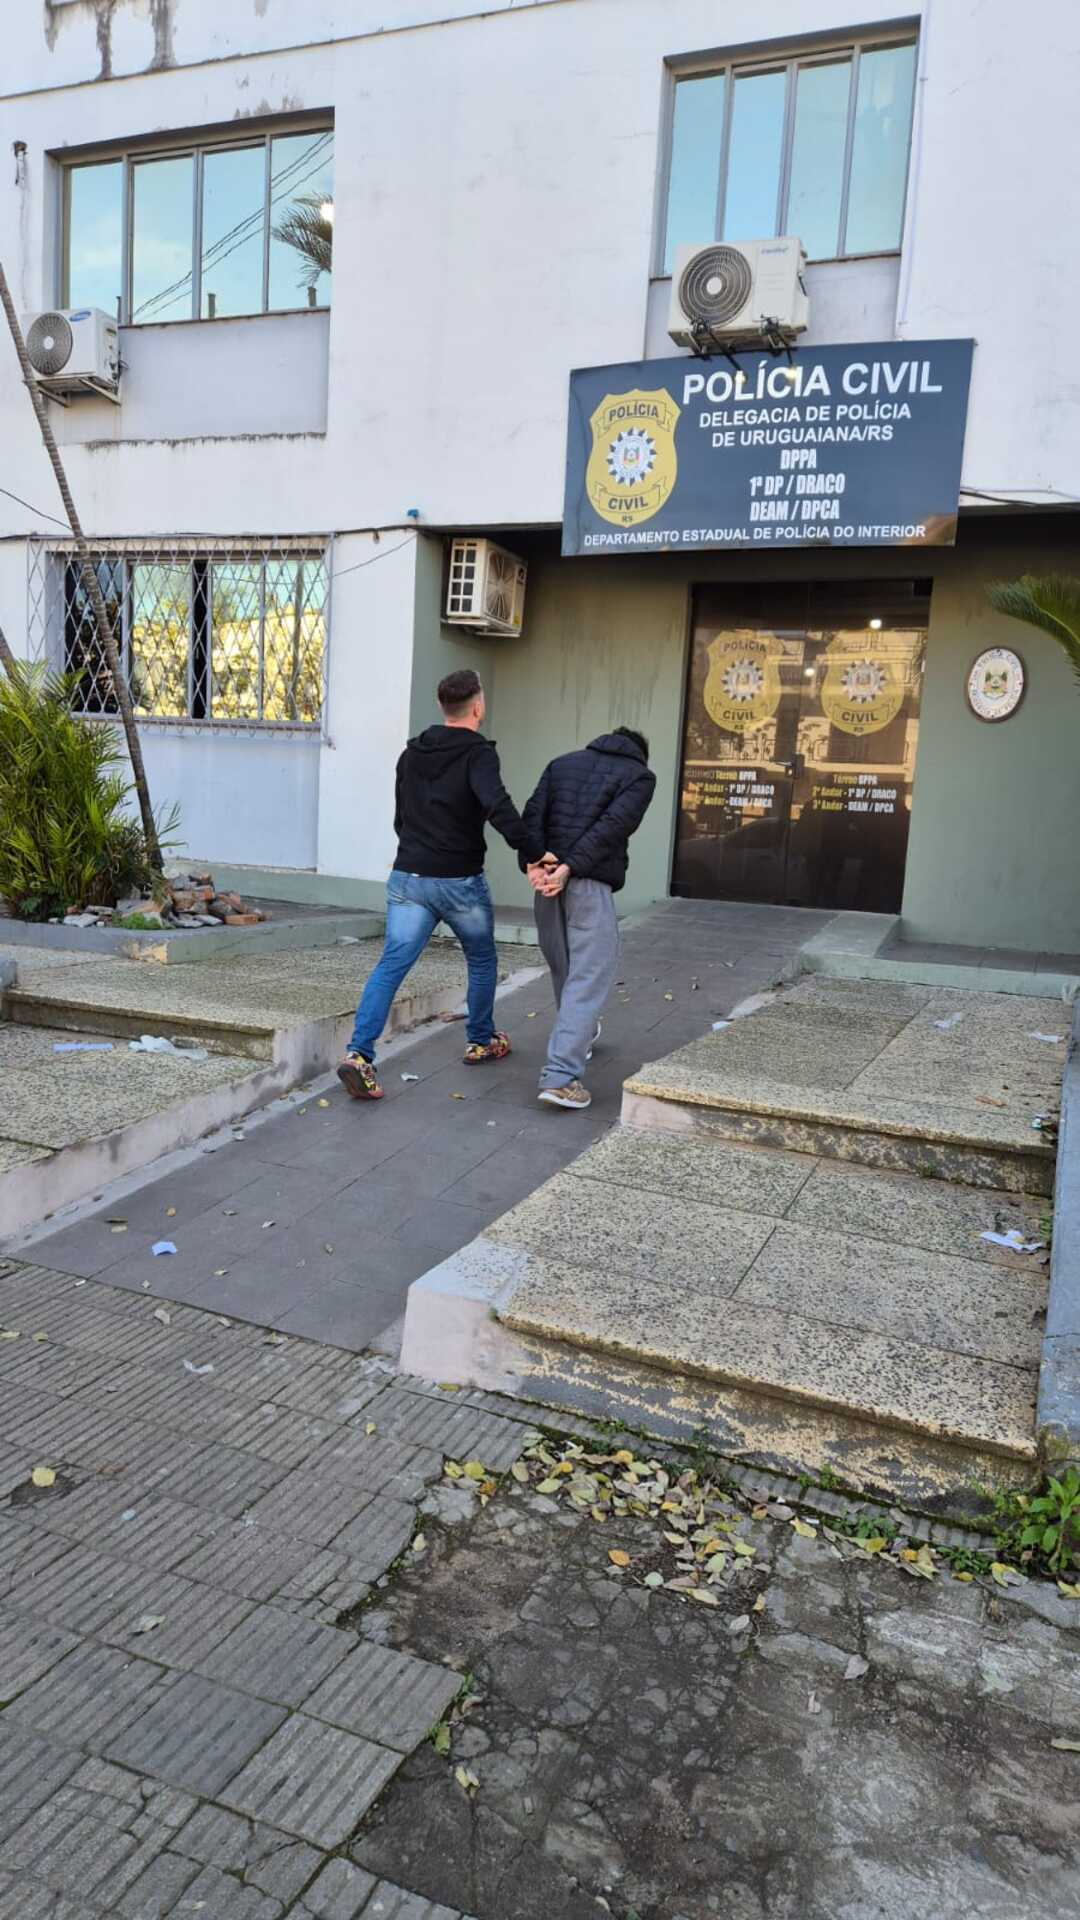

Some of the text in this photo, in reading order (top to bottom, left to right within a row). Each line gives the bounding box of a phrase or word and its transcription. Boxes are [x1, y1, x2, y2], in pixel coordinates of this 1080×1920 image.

[683, 360, 943, 405] POLÍCIA CIVIL
[609, 402, 660, 422] POLÍCIA
[699, 400, 912, 428] DELEGACIA DE POLÍCIA
[712, 424, 894, 448] DE URUGUAIANA/RS
[780, 448, 817, 470] DPPA
[764, 475, 784, 496] DP
[785, 474, 795, 496] /
[796, 473, 846, 495] DRACO
[607, 496, 649, 511] CIVIL
[750, 498, 840, 522] DEAM / DPCA
[584, 524, 927, 546] DEPARTAMENTO ESTADUAL DE POLÍCIA DO INTERIOR
[722, 709, 757, 721] CIVIL
[841, 710, 879, 723] CIVIL
